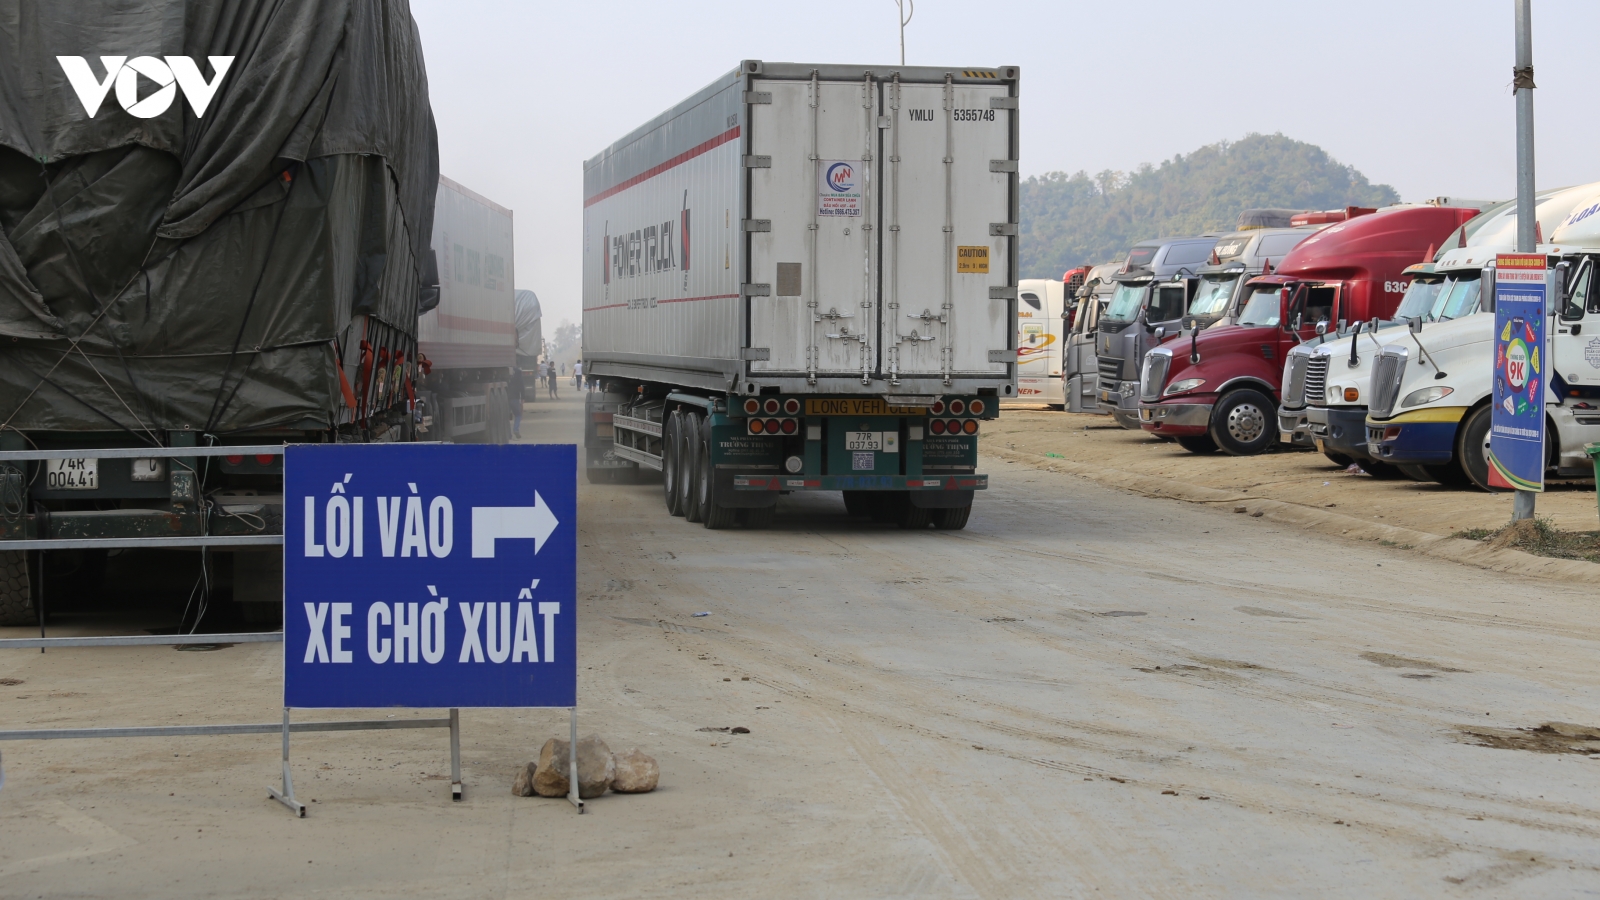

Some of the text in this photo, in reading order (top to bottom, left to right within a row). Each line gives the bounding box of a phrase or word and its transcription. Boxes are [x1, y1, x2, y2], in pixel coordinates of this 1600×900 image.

[909, 109, 995, 122] YMLU 5355748
[612, 219, 676, 280] POWER TRUCK
[959, 248, 987, 258] CAUTION
[1510, 361, 1524, 380] 9K
[811, 401, 848, 414] LONG
[855, 432, 872, 441] 77R
[719, 440, 749, 448] TRƯỜNG
[849, 441, 879, 450] 037.93
[48, 470, 95, 487] 004.41
[304, 473, 454, 559] LỐI VÀO
[303, 578, 561, 665] XE CHỜ XUẤT
